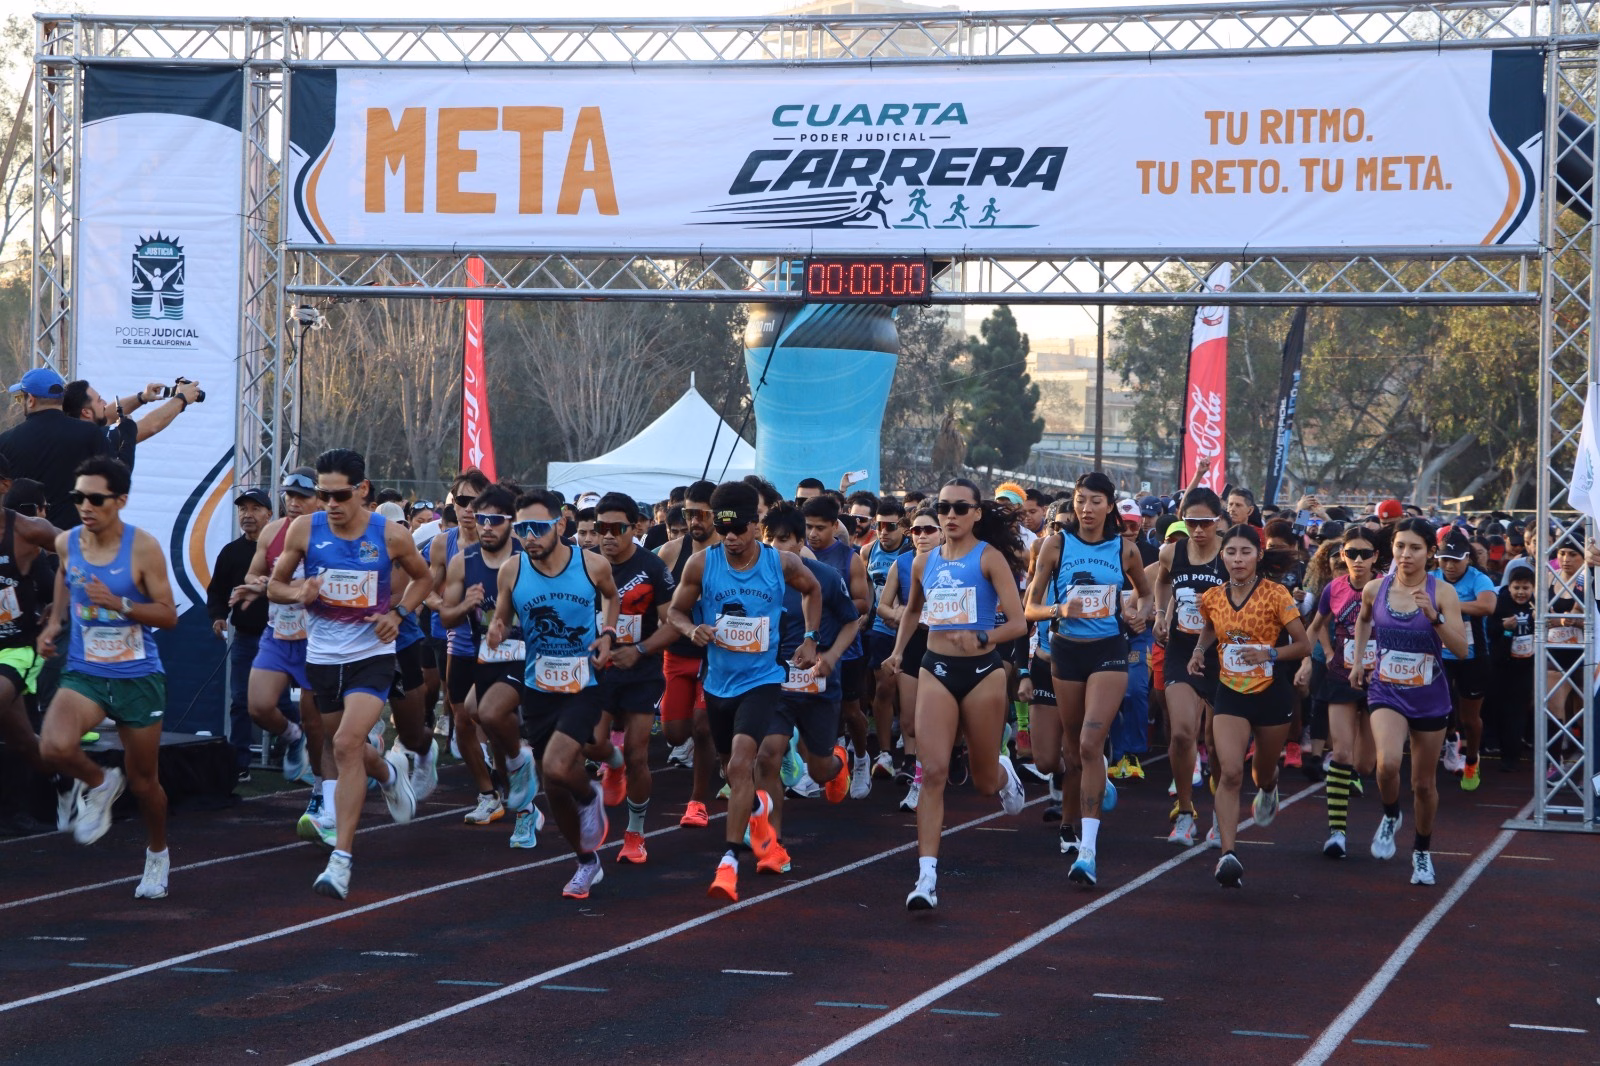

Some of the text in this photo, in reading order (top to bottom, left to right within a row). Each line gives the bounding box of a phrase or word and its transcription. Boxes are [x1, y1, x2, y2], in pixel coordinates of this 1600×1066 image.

[771, 102, 969, 127] CUARTA
[1204, 107, 1374, 146] TU RITMO.
[800, 132, 926, 143] PODER JUDICIAL
[364, 106, 620, 216] META
[728, 146, 1069, 196] CARRERA
[1136, 155, 1453, 195] TU RETO. TU META.
[144, 247, 174, 256] JUSTICIA
[808, 264, 925, 295] 00:00:00
[115, 326, 199, 338] PODER JUDICIAL
[1065, 557, 1119, 574] CLUB POTROS
[328, 582, 359, 595] 1119
[523, 592, 591, 612] CLUB POTROS
[715, 588, 773, 603] CLUB POTROS
[1078, 596, 1100, 607] 93
[933, 601, 959, 613] 2910
[723, 628, 753, 641] 1080
[92, 639, 123, 651] 3032
[1350, 650, 1375, 661] 149
[544, 669, 569, 681] 618
[1388, 663, 1417, 676] 1054
